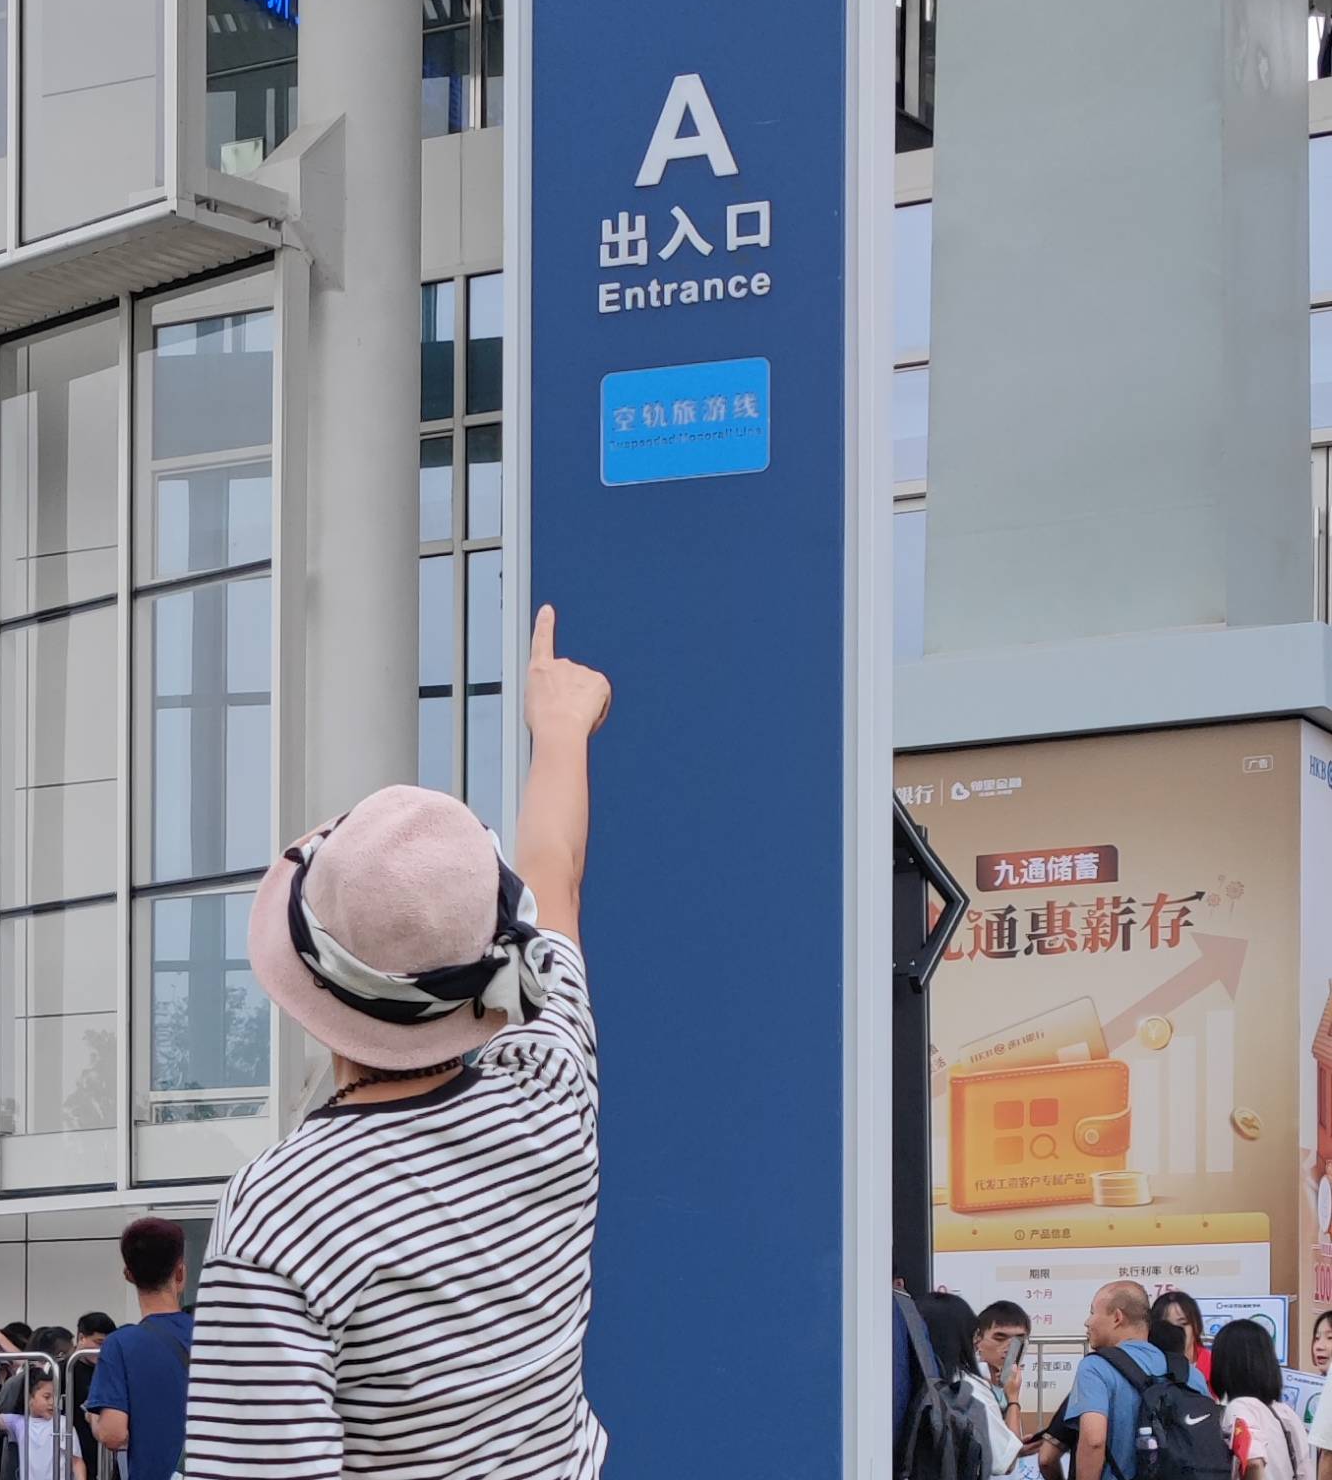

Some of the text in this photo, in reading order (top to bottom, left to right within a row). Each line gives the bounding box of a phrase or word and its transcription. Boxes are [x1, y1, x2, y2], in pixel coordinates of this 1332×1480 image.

[634, 73, 739, 187] A
[599, 200, 771, 268] 出入口
[598, 271, 771, 313] Entrance
[613, 392, 760, 432] 空轨旅游线
[994, 853, 1100, 887] 九通储蓄
[1030, 1228, 1071, 1241] 产品信息
